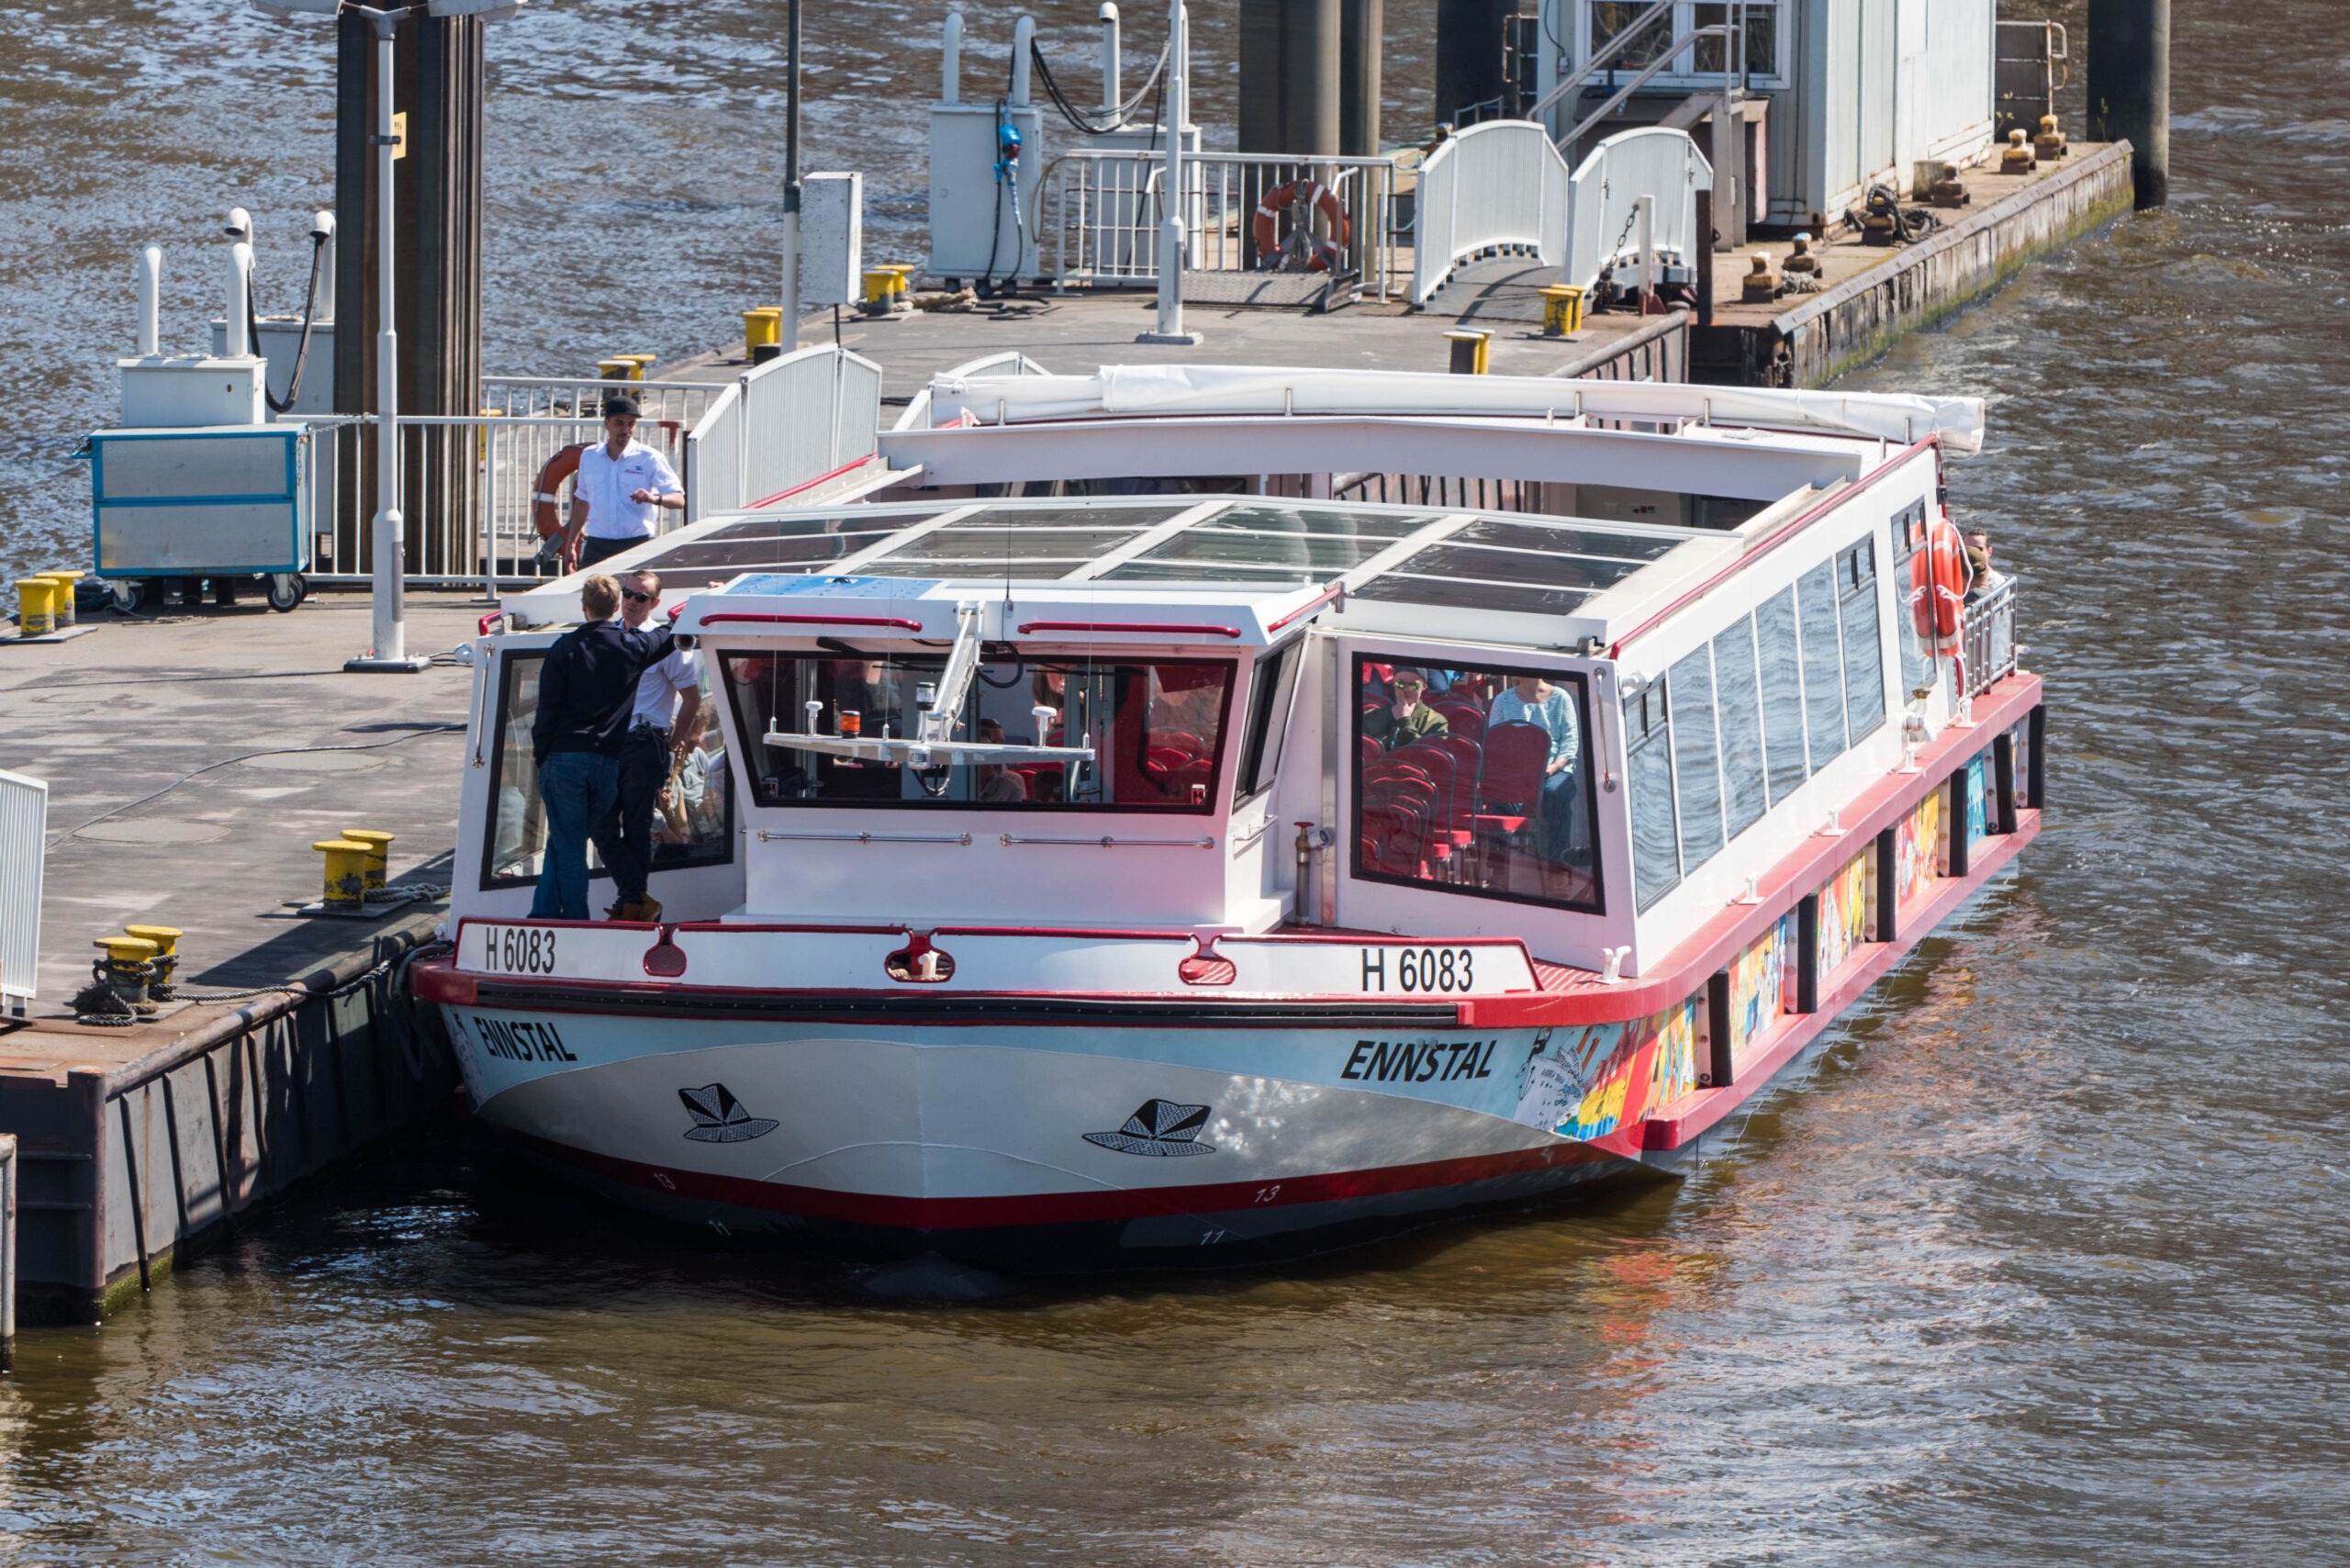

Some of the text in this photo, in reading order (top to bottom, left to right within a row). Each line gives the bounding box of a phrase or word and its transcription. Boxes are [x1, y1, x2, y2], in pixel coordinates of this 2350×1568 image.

[487, 926, 556, 974] H 6083
[1361, 947, 1473, 992] H 6083
[473, 1015, 578, 1062] ENNSTAL
[1340, 1039, 1497, 1082] ENNSTAL
[1254, 1184, 1281, 1204] 13
[1200, 1229, 1225, 1246] 11
